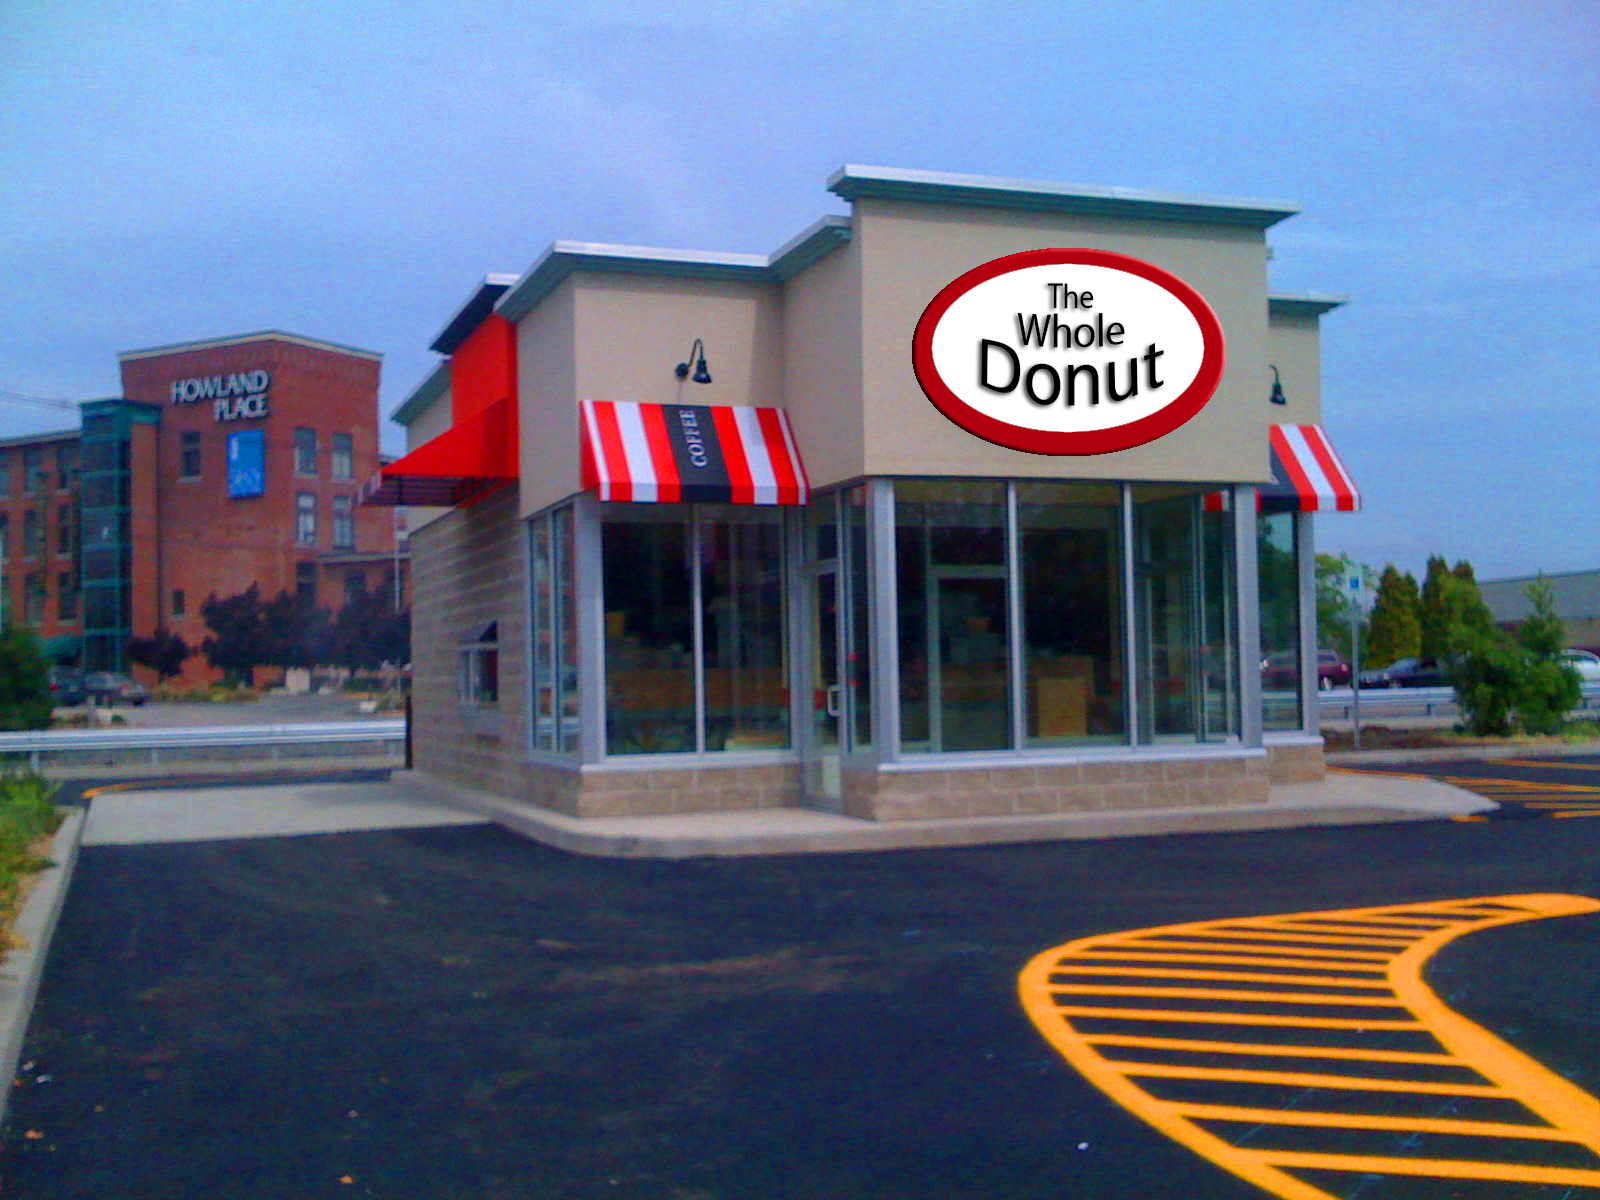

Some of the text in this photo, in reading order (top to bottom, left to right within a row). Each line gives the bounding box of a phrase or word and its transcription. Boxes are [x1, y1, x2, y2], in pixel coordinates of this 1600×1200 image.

[1047, 283, 1094, 309] The
[1017, 312, 1125, 348] Whole
[170, 369, 269, 403] HOWLAND
[980, 338, 1164, 406] Donut
[213, 392, 268, 421] PLACE
[678, 409, 708, 468] COFFEE
